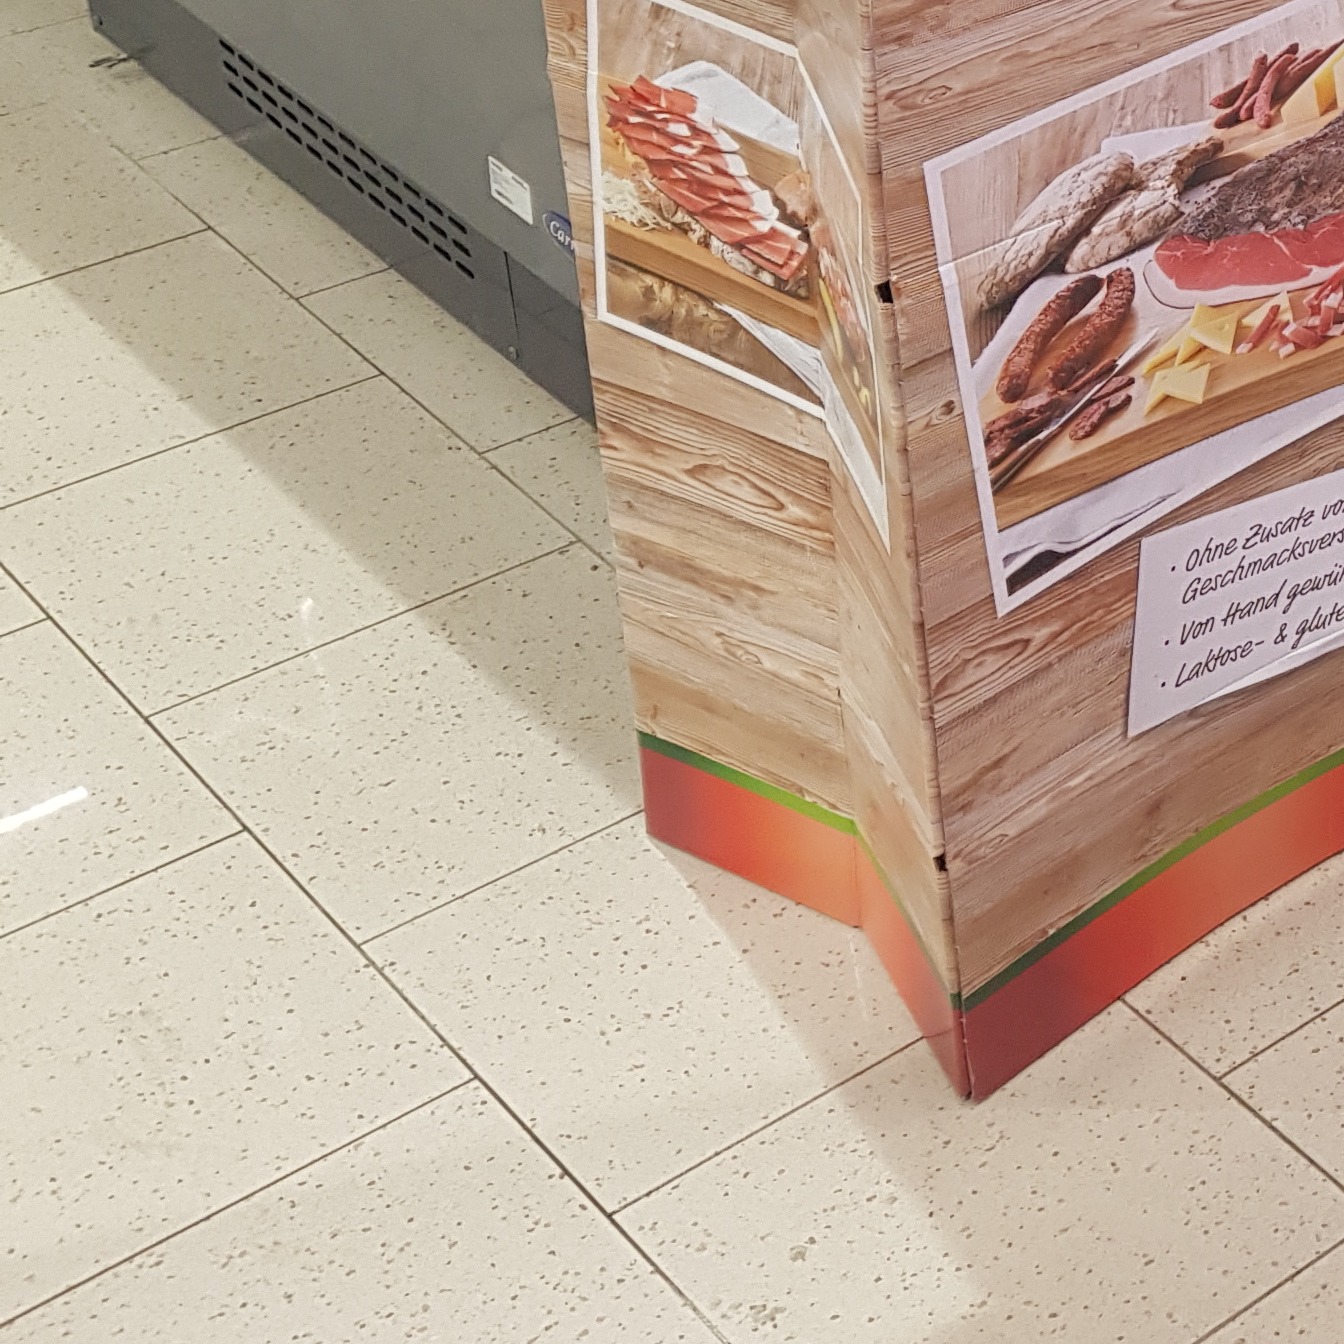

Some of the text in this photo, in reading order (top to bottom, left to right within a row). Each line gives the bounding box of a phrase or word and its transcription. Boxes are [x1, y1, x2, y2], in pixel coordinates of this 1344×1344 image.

[1186, 536, 1238, 573] Ohne
[1242, 506, 1315, 551] Zusatz
[1180, 616, 1216, 646] Von
[1220, 587, 1281, 631] Hand
[1175, 638, 1266, 689] Laktose-
[1274, 623, 1288, 645] &
